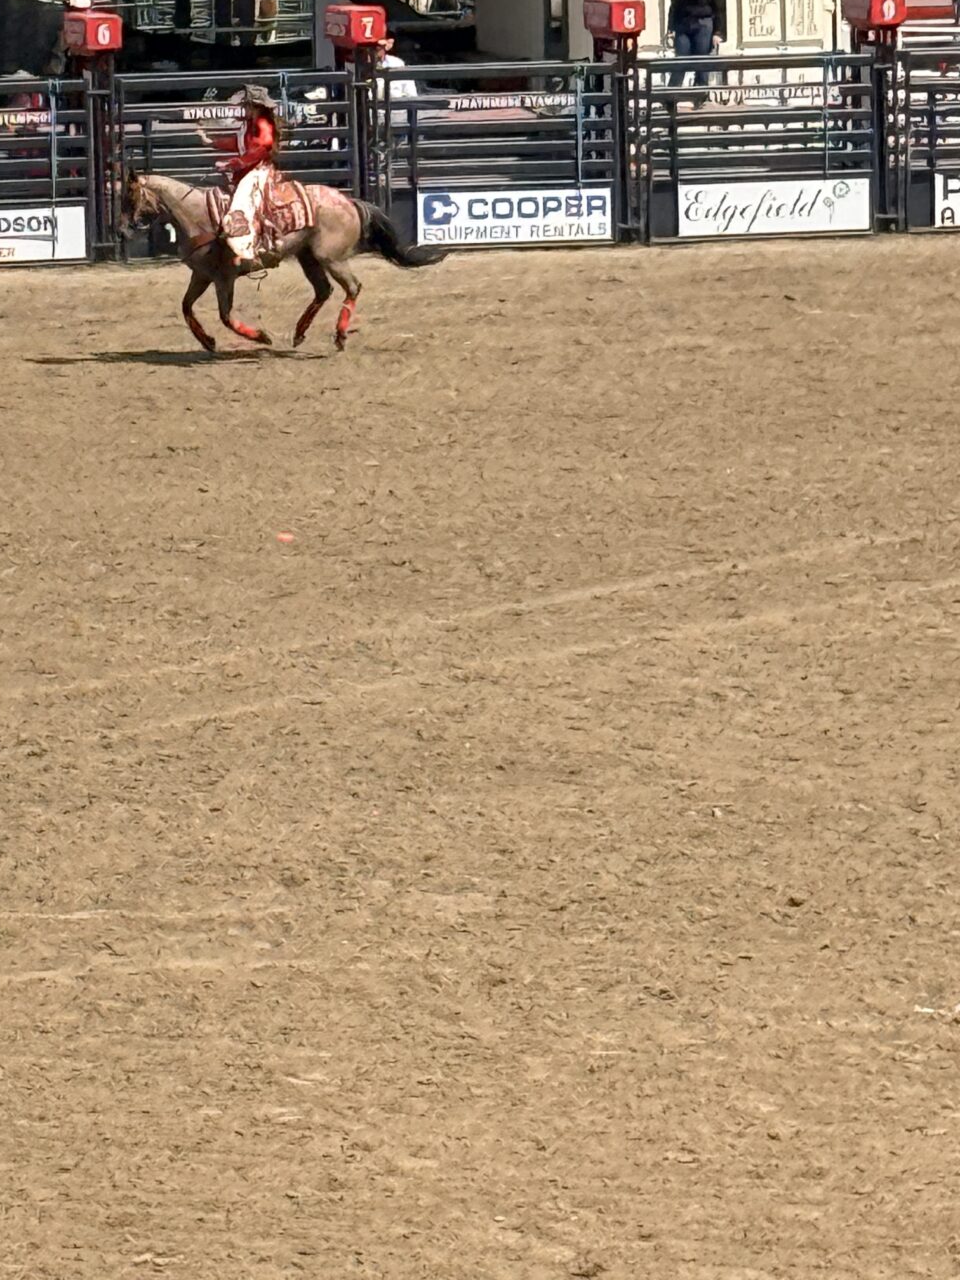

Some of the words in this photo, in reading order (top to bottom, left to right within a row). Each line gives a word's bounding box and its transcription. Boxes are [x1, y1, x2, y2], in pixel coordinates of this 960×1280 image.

[361, 16, 374, 39] 7
[623, 7, 637, 30] 8
[97, 23, 111, 46] 6
[467, 195, 607, 221] COOPER
[684, 188, 823, 233] Edgefield
[423, 225, 522, 242] EQUIPMENT
[529, 222, 607, 239] RENTALS
